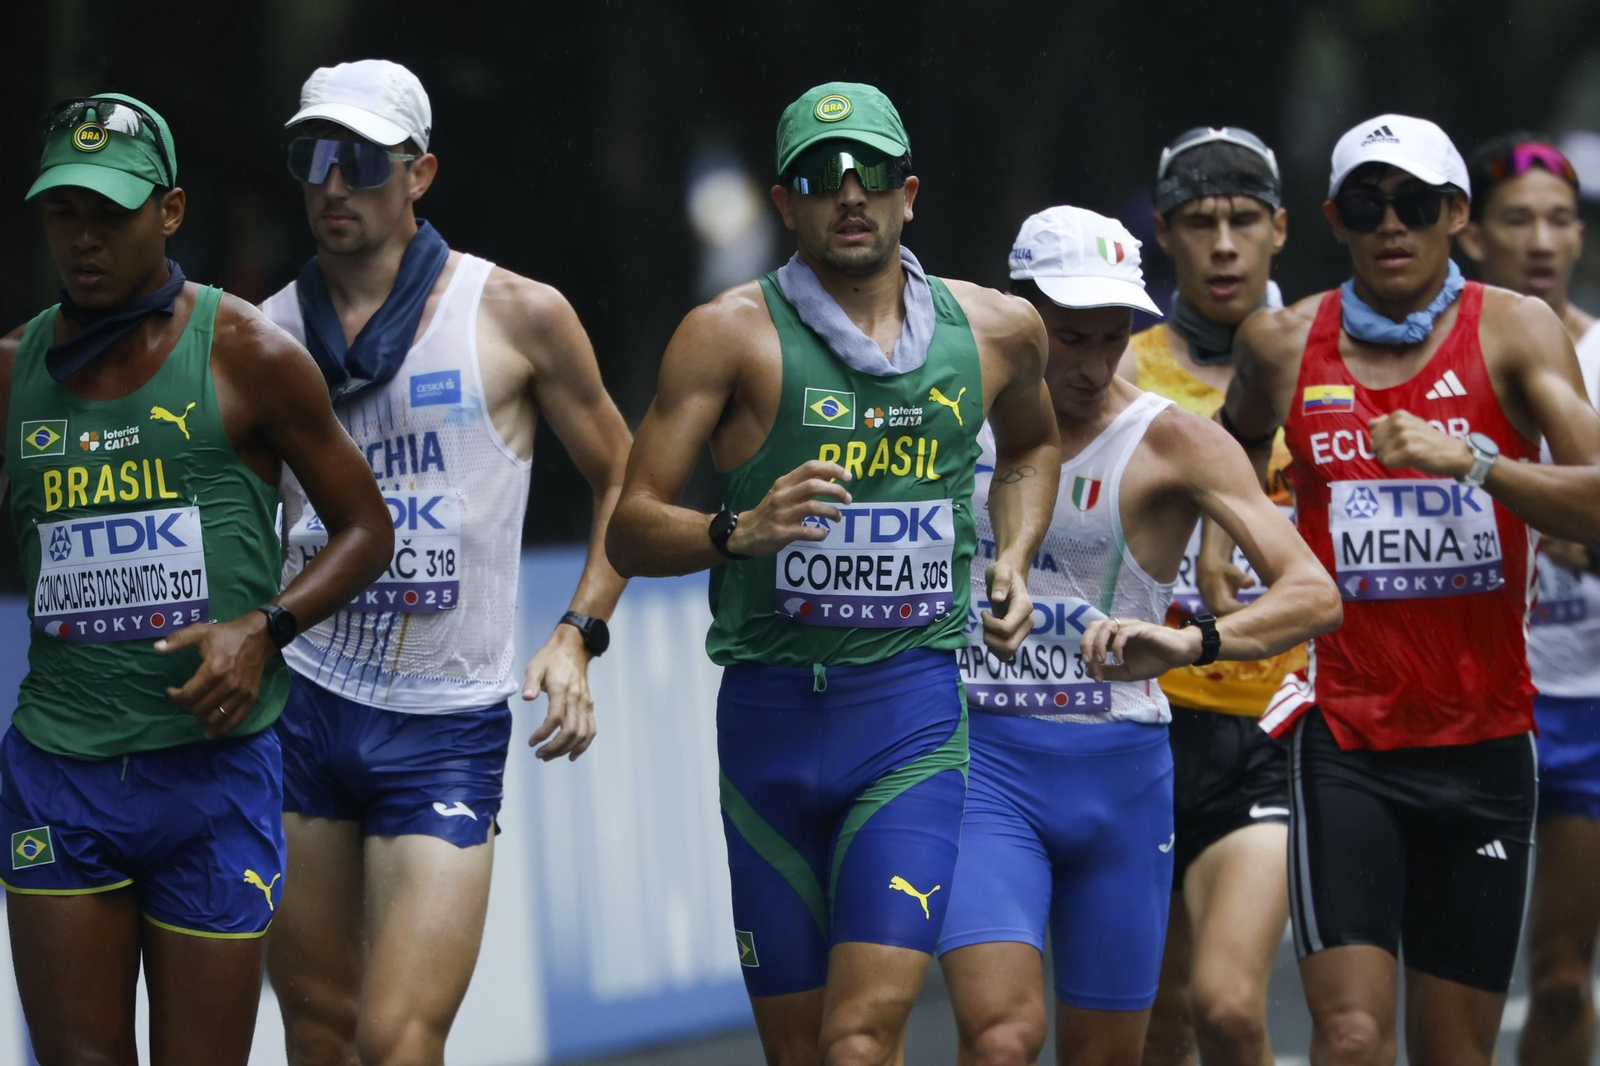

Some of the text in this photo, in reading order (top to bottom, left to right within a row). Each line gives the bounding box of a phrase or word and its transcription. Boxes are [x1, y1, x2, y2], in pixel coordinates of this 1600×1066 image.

[823, 103, 844, 114] BRA
[80, 131, 100, 141] BRA
[888, 405, 923, 417] loterias
[888, 416, 923, 427] CAIXA
[103, 425, 140, 440] loterias
[103, 436, 140, 451] CAIXA
[1310, 418, 1471, 465] ECUR
[359, 431, 446, 480] CHIA
[43, 458, 178, 513] BRASIL
[384, 496, 447, 531] DK
[1379, 485, 1483, 518] TDK
[71, 512, 188, 558] TDK
[838, 505, 944, 543] TDK
[1341, 528, 1499, 567] MENA 321
[426, 548, 456, 578] 318
[784, 551, 949, 592] CORREA 306
[1472, 569, 1498, 586] 25
[37, 563, 203, 613] GONCALVES DOS SANTOS 307
[350, 589, 452, 606] KYO 25
[172, 608, 201, 625] 25
[918, 601, 946, 616] 25
[958, 644, 1068, 680] APORASO
[1075, 690, 1104, 706] 25
